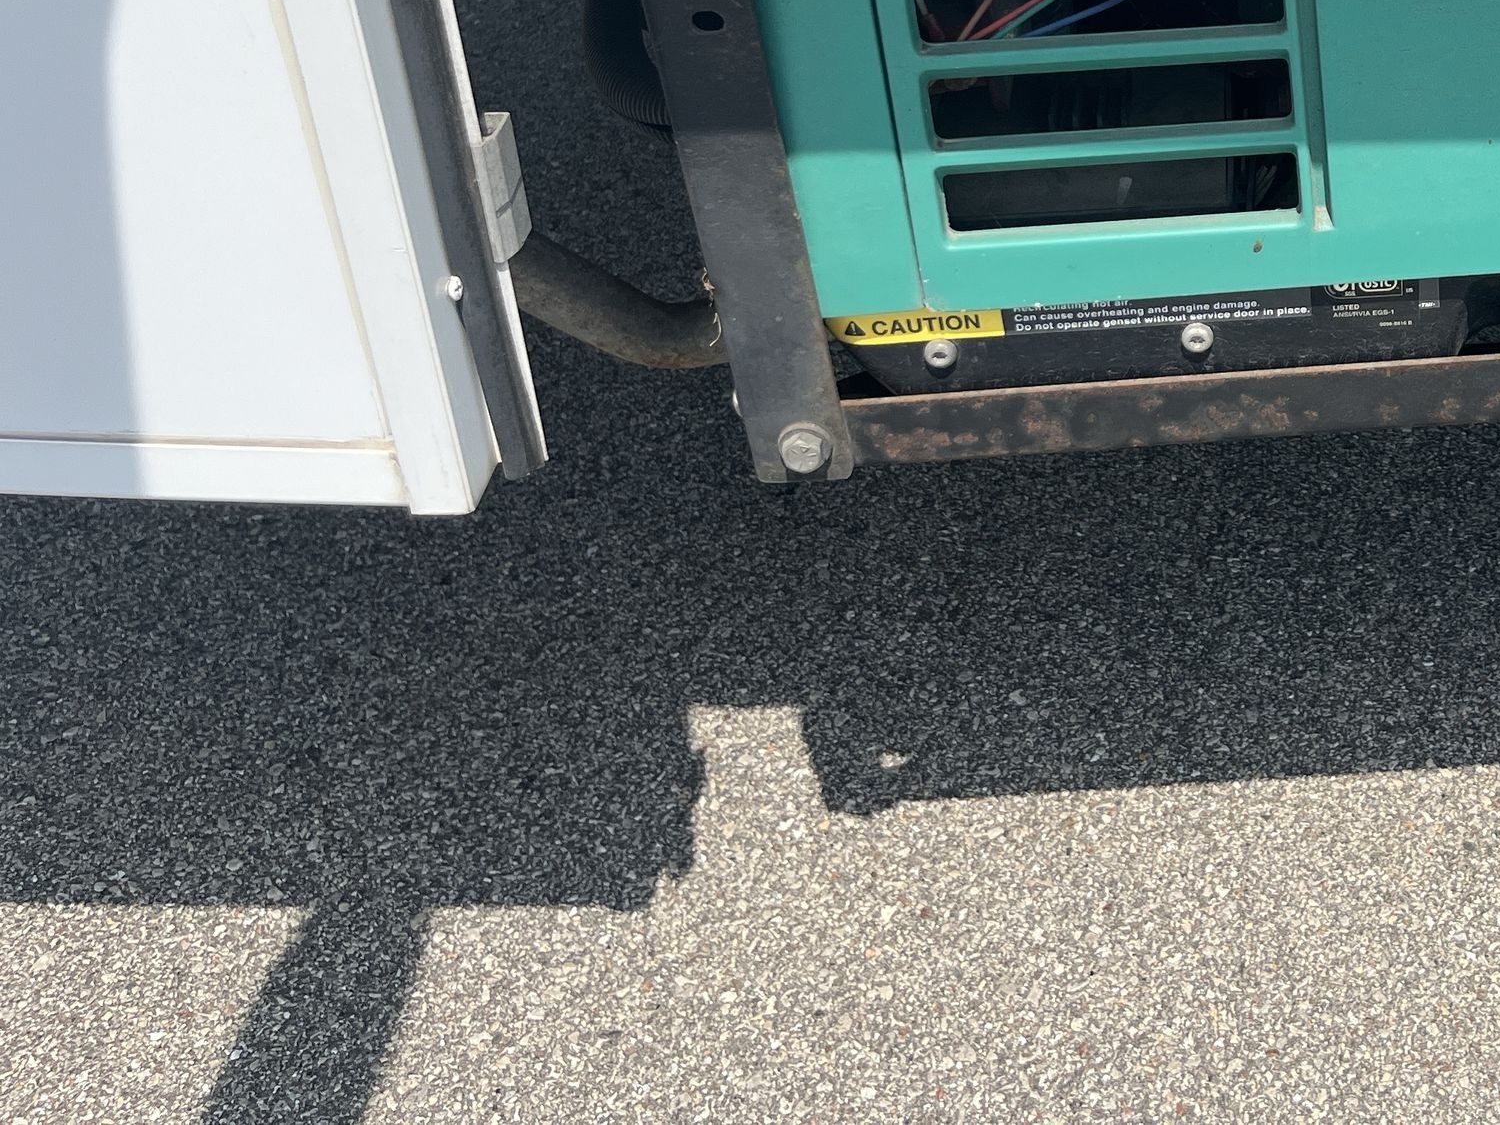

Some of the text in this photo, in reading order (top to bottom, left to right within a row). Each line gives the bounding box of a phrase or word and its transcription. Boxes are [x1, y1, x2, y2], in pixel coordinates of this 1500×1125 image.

[1014, 300, 1260, 322] Can cause overheating and engine damage.
[1016, 305, 1311, 331] Do not operate genset without service door in place.
[872, 314, 981, 336] CAUTION
